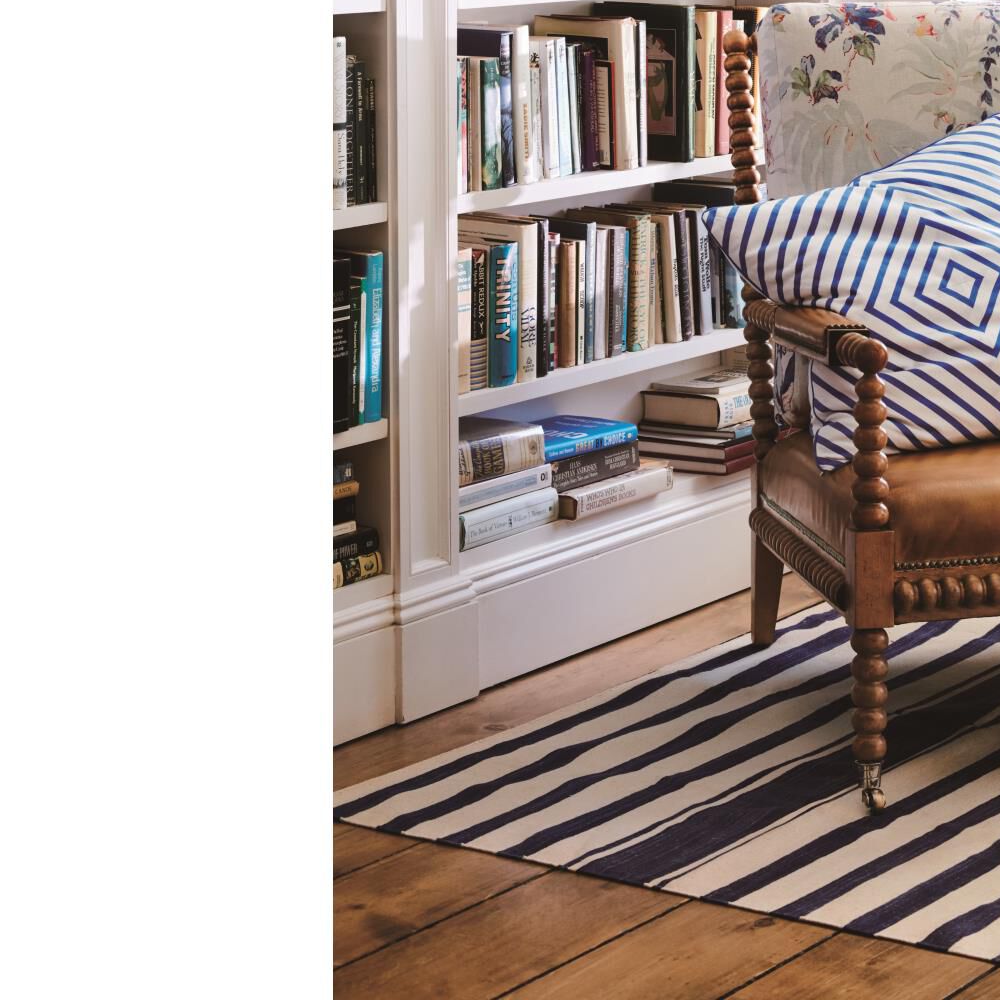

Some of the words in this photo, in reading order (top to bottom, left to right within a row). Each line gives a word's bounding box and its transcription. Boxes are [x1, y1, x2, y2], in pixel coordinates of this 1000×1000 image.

[337, 133, 345, 153] Sara
[371, 288, 382, 328] Elizabeth
[495, 258, 511, 342] TRINITY
[372, 329, 382, 345] and
[521, 308, 529, 348] VIDAL
[370, 348, 381, 393] Alexandra
[575, 439, 594, 452] GREAT
[595, 439, 603, 449] BY
[603, 432, 626, 447] CHOICE
[482, 451, 492, 474] BOOK
[339, 543, 358, 558] POWER
